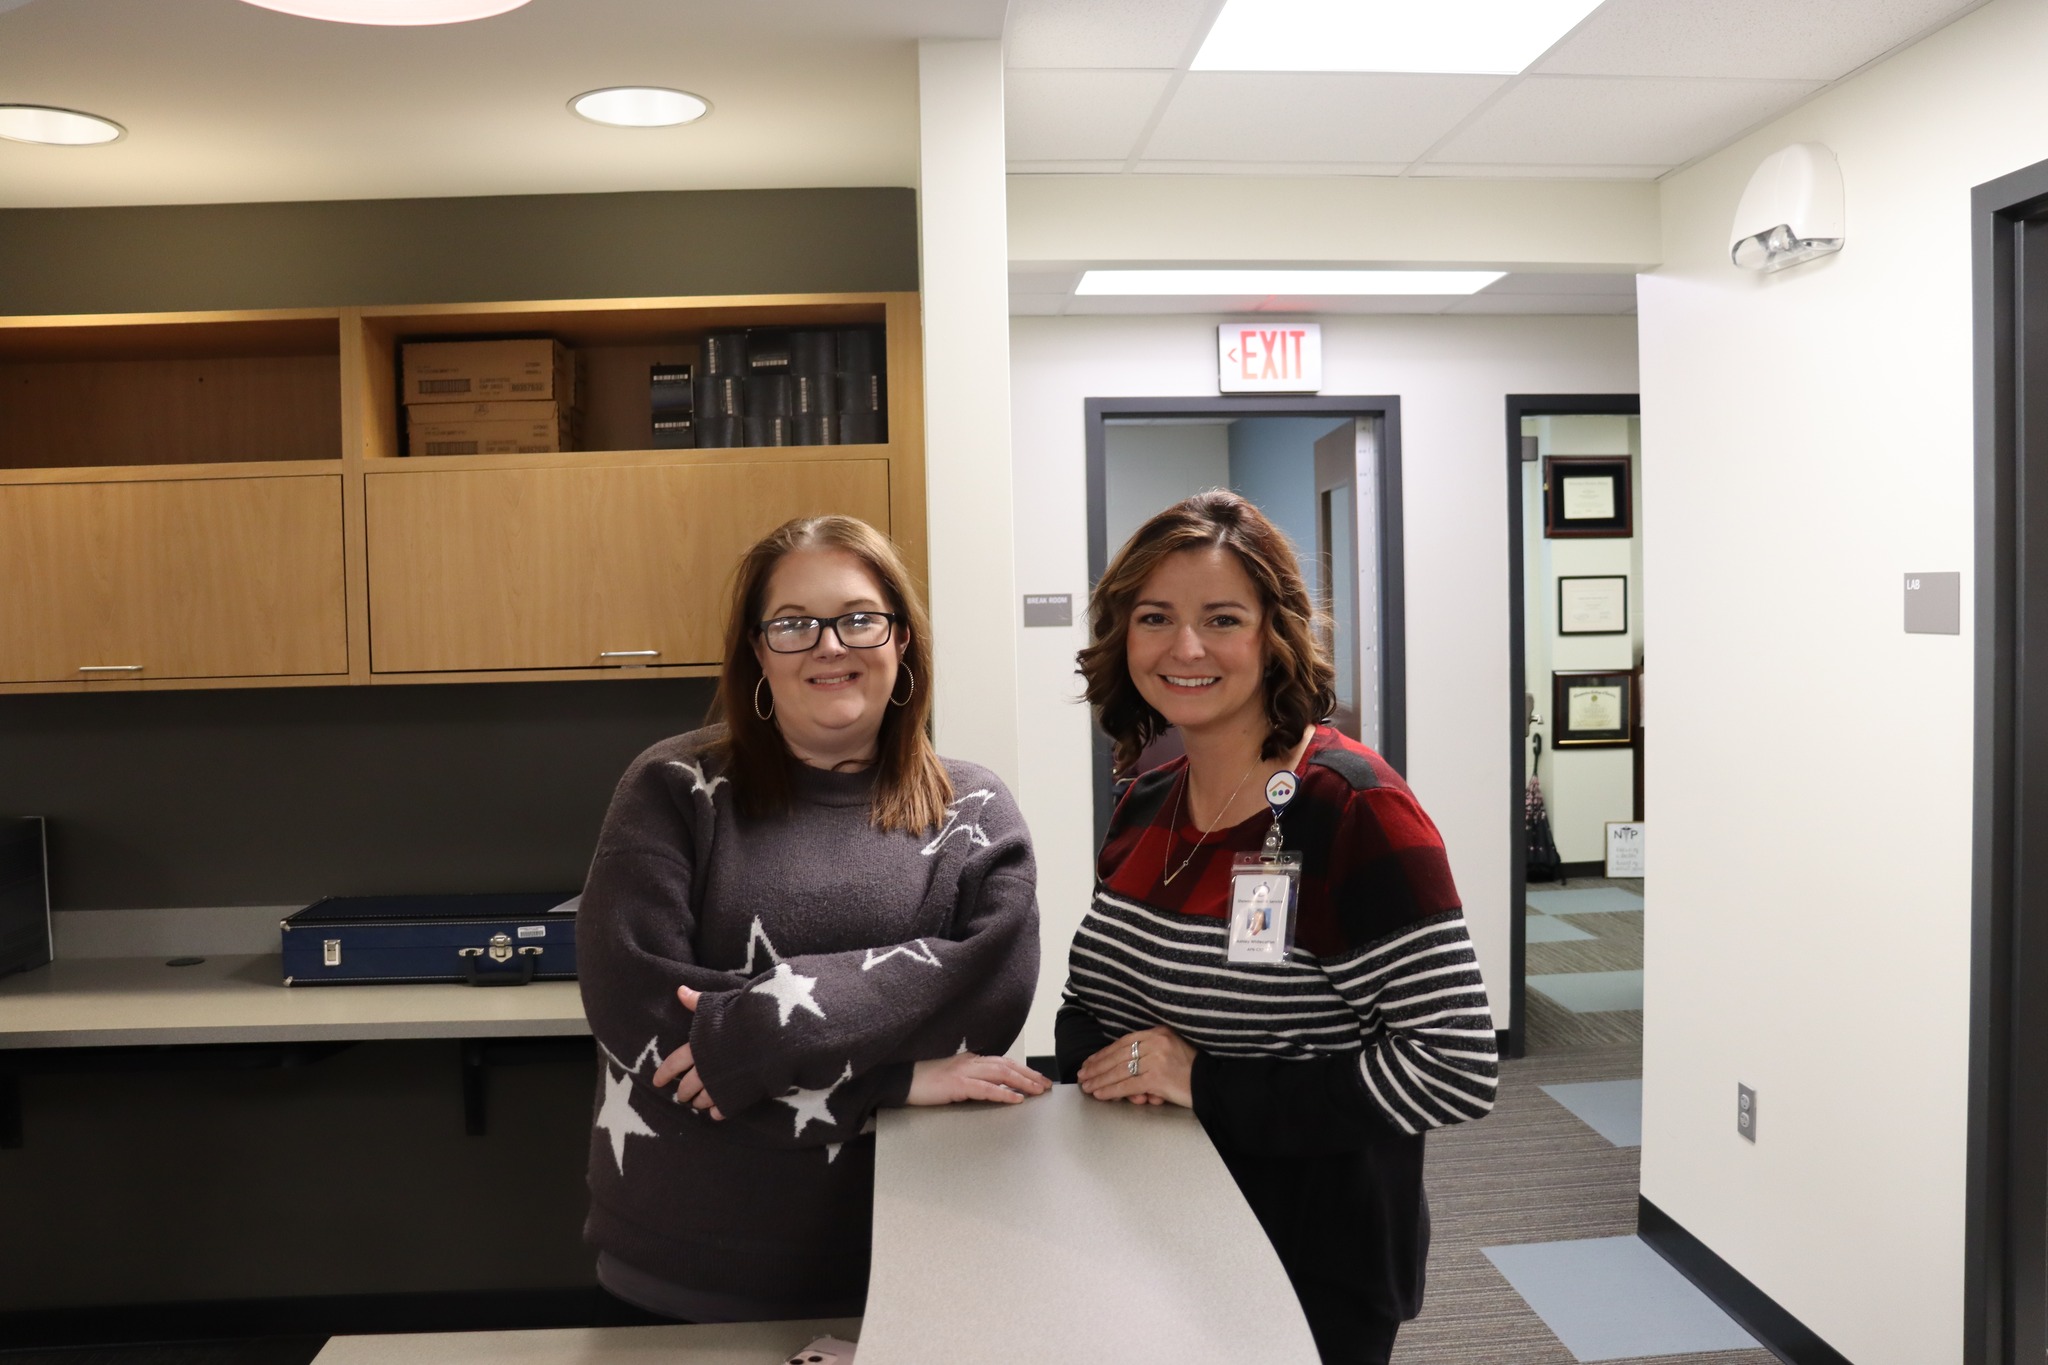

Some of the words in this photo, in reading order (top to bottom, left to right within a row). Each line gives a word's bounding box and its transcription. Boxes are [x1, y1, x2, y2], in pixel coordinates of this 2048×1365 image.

[1240, 330, 1305, 379] EXIT
[1906, 579, 1920, 590] LAB
[1048, 596, 1067, 604] ROOM
